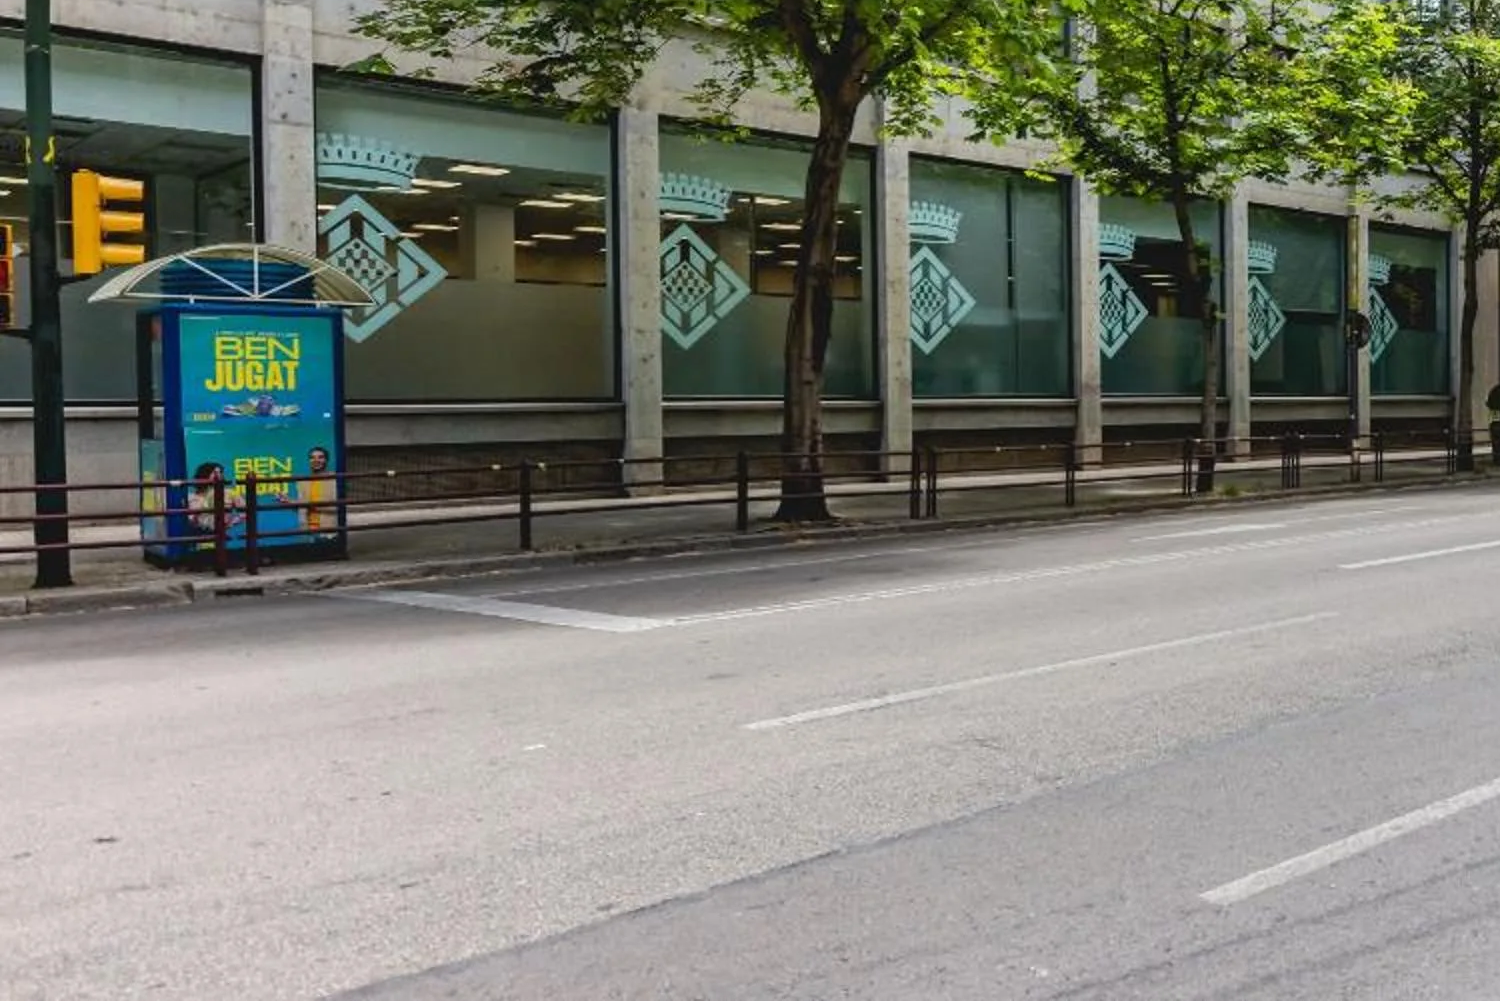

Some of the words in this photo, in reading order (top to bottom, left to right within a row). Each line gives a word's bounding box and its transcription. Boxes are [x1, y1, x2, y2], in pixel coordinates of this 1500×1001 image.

[215, 336, 299, 359] BEN
[205, 360, 299, 391] JUGAT
[234, 456, 292, 473] BEN
